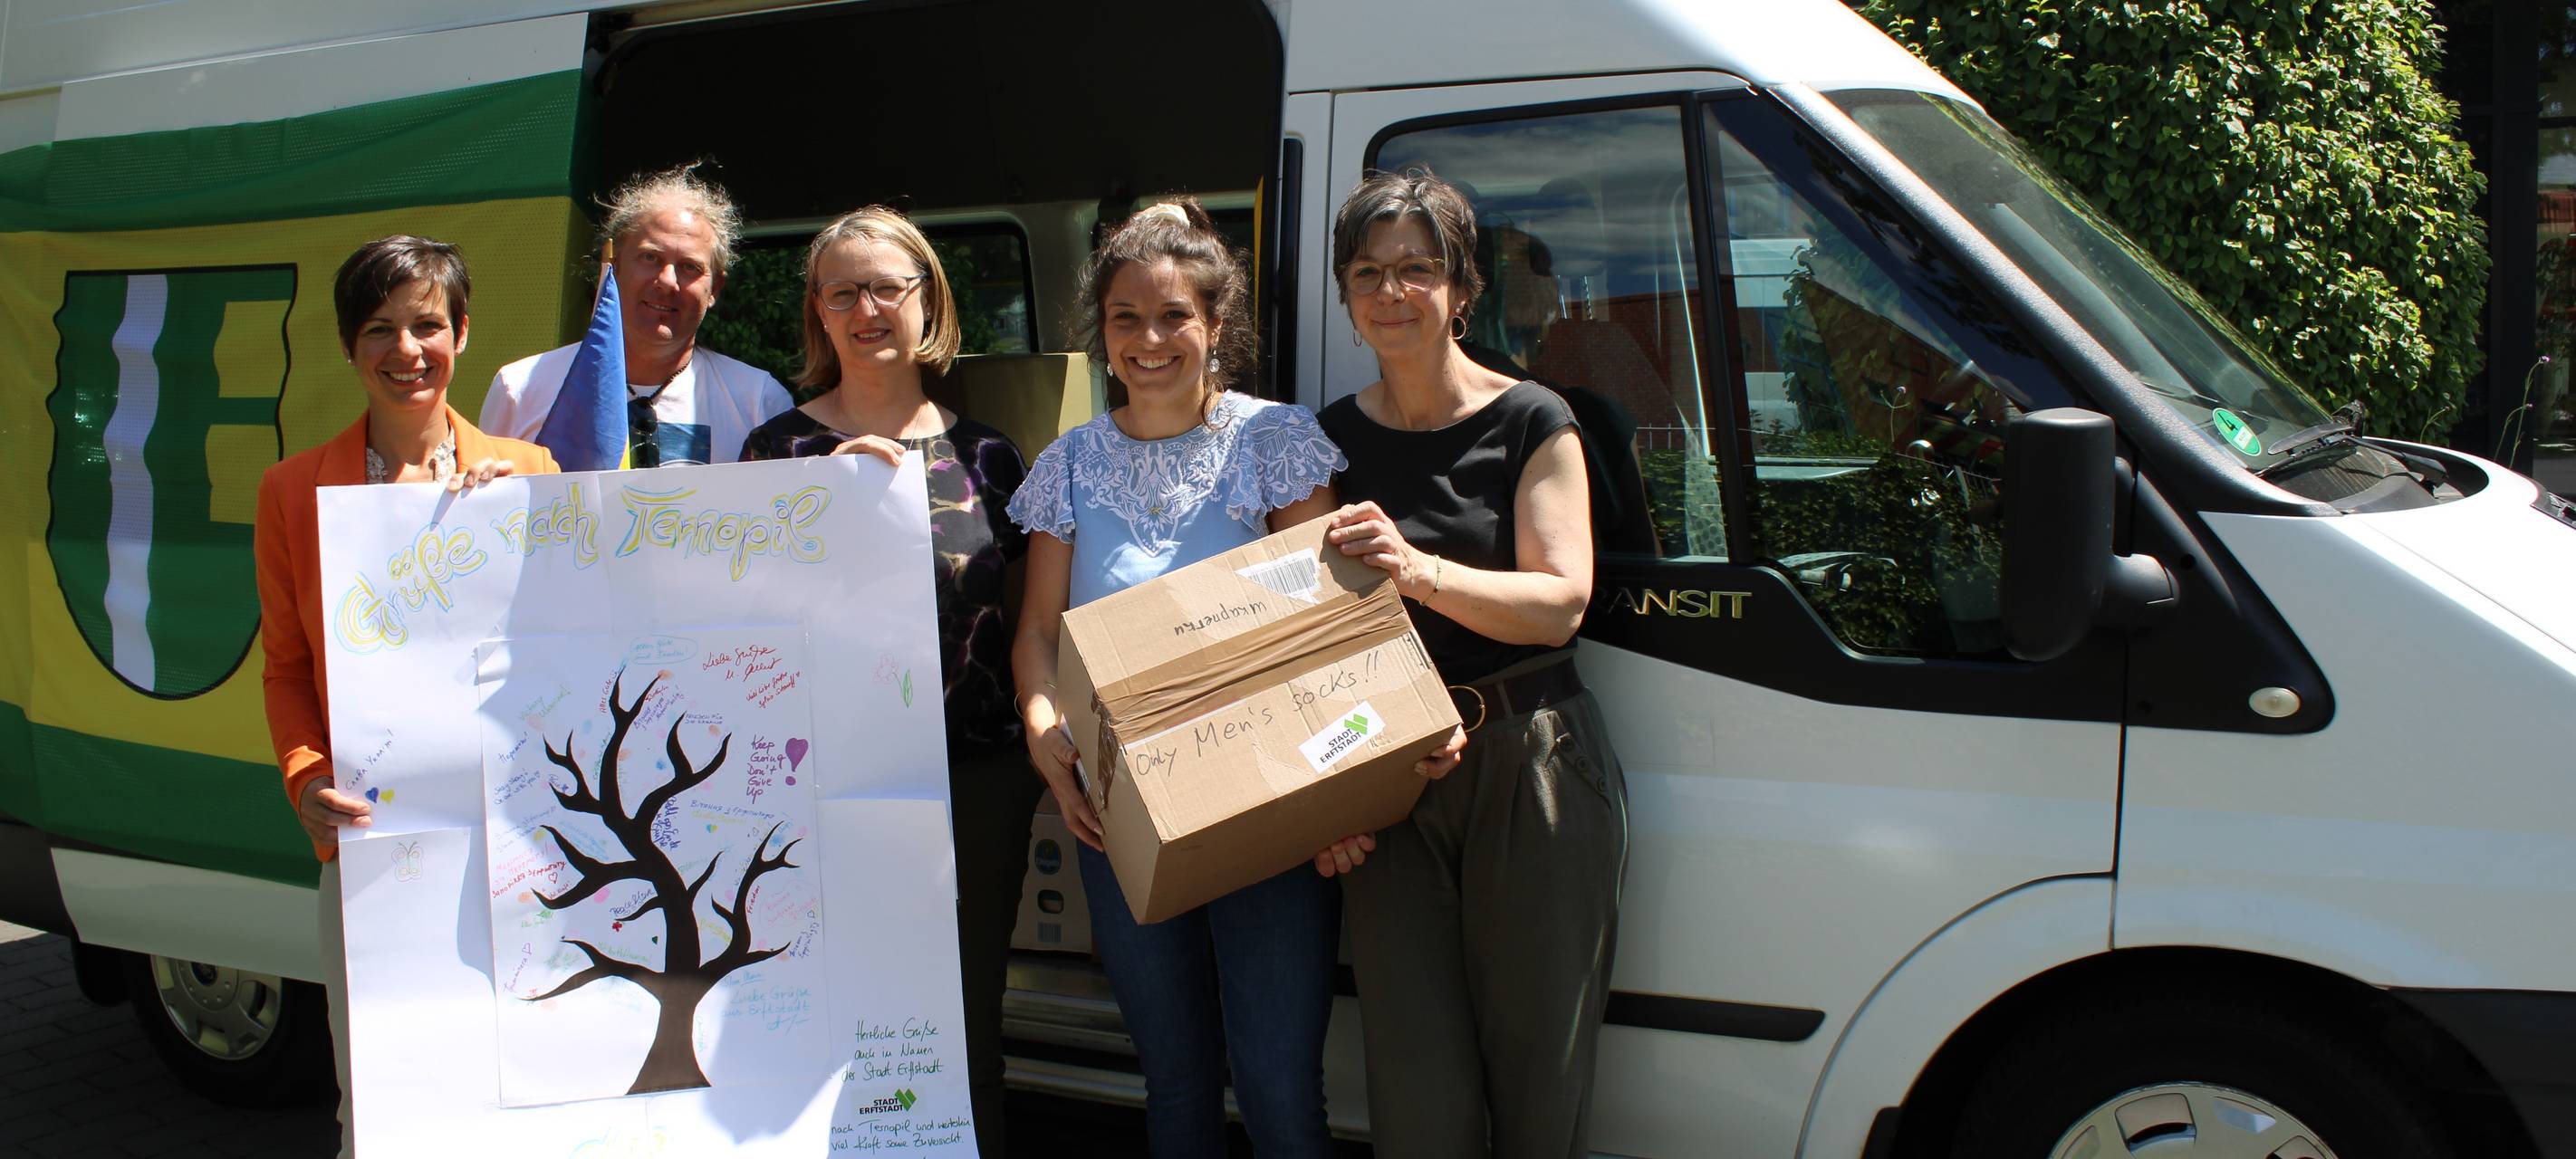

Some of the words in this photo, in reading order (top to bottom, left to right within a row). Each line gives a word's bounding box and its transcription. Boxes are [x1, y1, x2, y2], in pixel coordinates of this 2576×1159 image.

[2217, 412, 2239, 431] 4
[334, 522, 488, 654] Grüße
[491, 483, 599, 570] nach
[615, 484, 832, 582] Ternopil
[751, 734, 775, 754] Keep
[1136, 747, 1177, 777] Only
[1193, 707, 1273, 758] Men's
[1320, 732, 1362, 763] ERFTSTADT
[1328, 728, 1353, 748] STADT
[747, 763, 778, 776] Don't
[749, 753, 786, 771] Going
[747, 776, 774, 787] Give
[745, 786, 764, 805] Up
[855, 1020, 897, 1041] Herzliche
[902, 1017, 939, 1041] Grüße
[854, 1048, 875, 1060] auch
[900, 1043, 934, 1057] Namen
[842, 1064, 855, 1082] der
[863, 1061, 892, 1081] Stadt
[897, 1058, 944, 1081] Erftstadt
[859, 1104, 904, 1115] ERFTSTADT
[873, 1097, 899, 1106] STADT
[831, 1124, 854, 1135] nach
[859, 1118, 911, 1136] Ternopil
[916, 1121, 934, 1132] und
[831, 1140, 848, 1151] viel
[853, 1135, 881, 1154] Kraft
[885, 1139, 908, 1148] sowie
